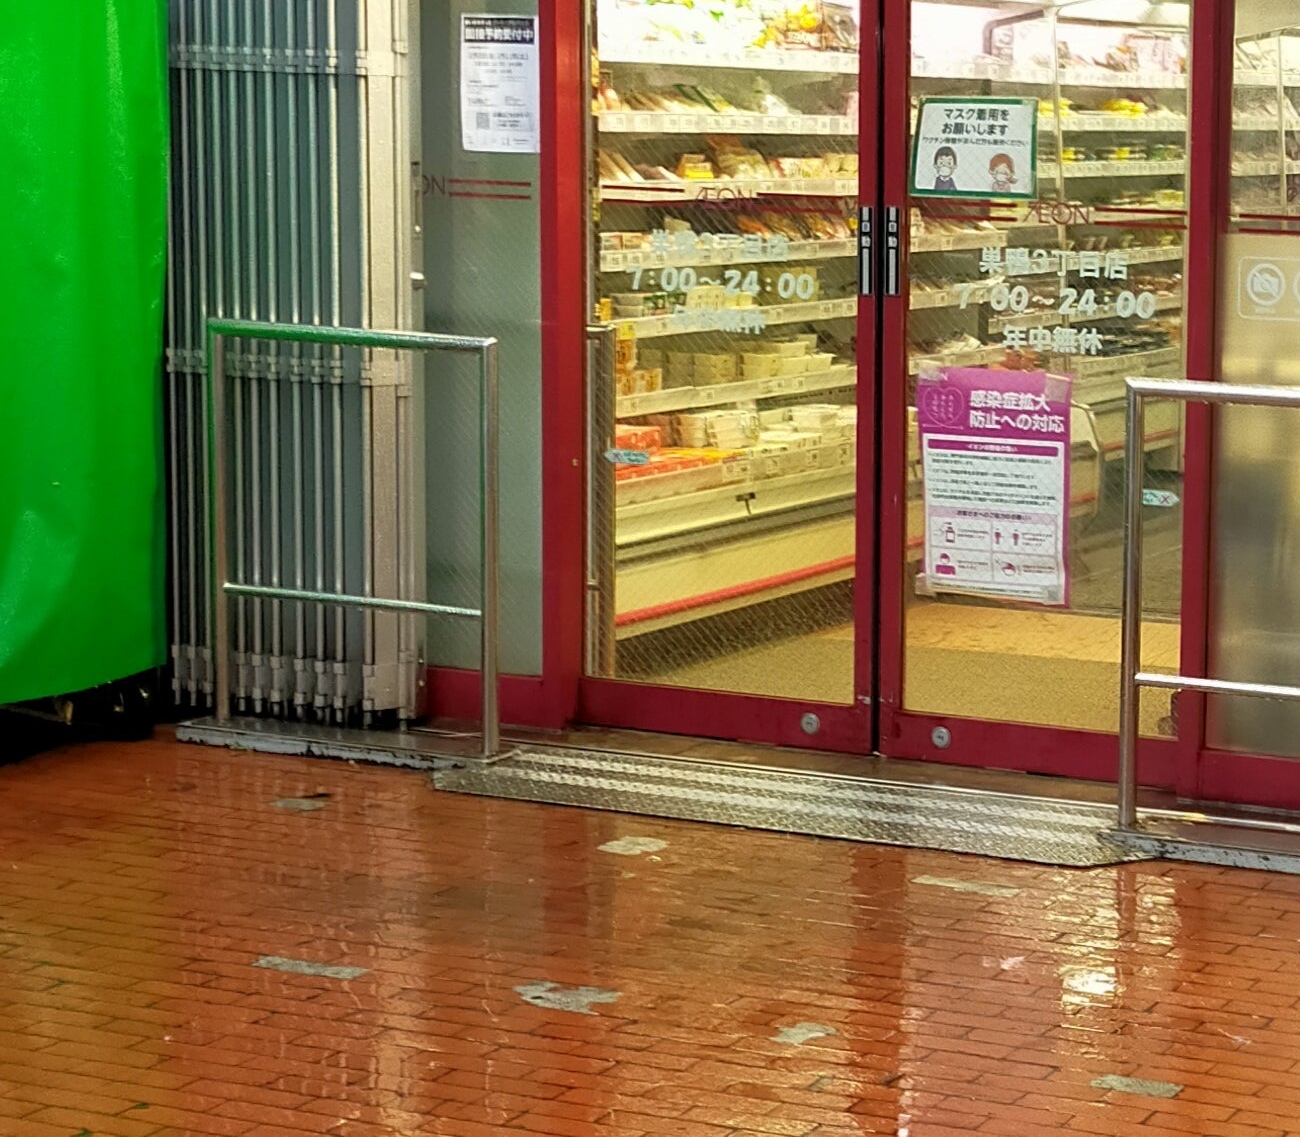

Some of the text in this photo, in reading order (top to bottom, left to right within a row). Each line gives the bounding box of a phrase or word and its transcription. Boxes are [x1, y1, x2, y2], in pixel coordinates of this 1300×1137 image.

[944, 108, 1010, 121] マスク着用を
[942, 122, 1008, 135] お願いします
[979, 245, 1129, 280] 巣鴨3丁目店
[1002, 324, 1103, 355] 年中無休
[969, 390, 1051, 412] 感染症拡大
[969, 410, 1065, 433] 防止への対応
